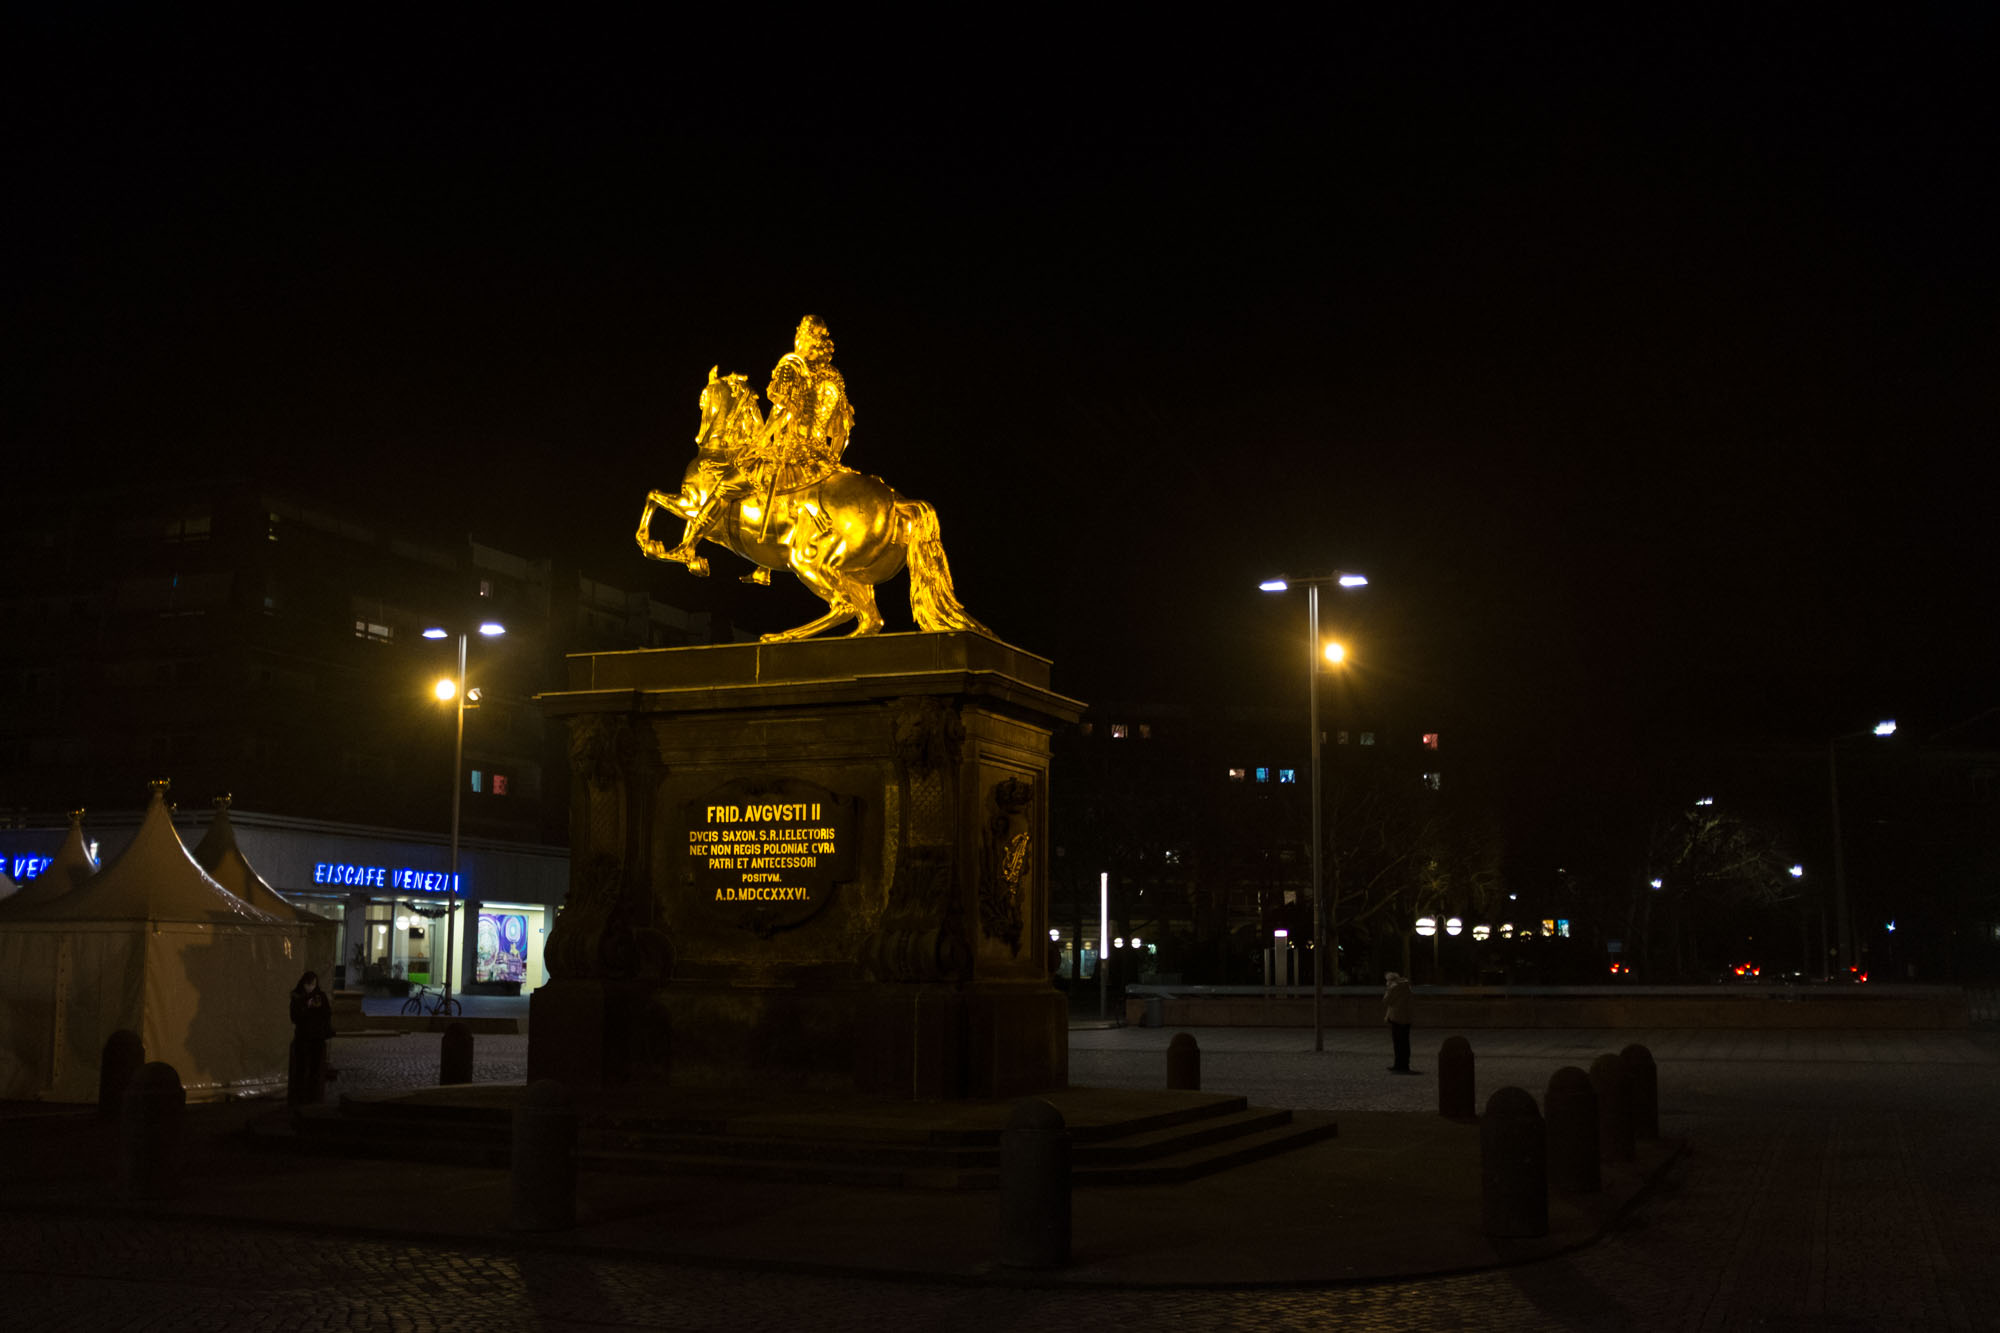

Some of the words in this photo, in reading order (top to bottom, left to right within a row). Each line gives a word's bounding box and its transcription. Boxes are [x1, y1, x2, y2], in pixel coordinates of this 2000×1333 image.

[811, 803, 821, 821] II
[689, 831, 719, 843] DVCIS
[689, 844, 708, 856] NEC
[710, 844, 732, 856] NON
[733, 843, 762, 855] REGIS
[763, 843, 809, 855] POLONIAE
[811, 842, 835, 854] CVRA
[709, 858, 734, 869] PATRI
[737, 858, 749, 869] ET
[751, 856, 816, 869] ANTECESSORI
[315, 864, 386, 887] EISCAFE
[742, 873, 782, 883] POSITVM.
